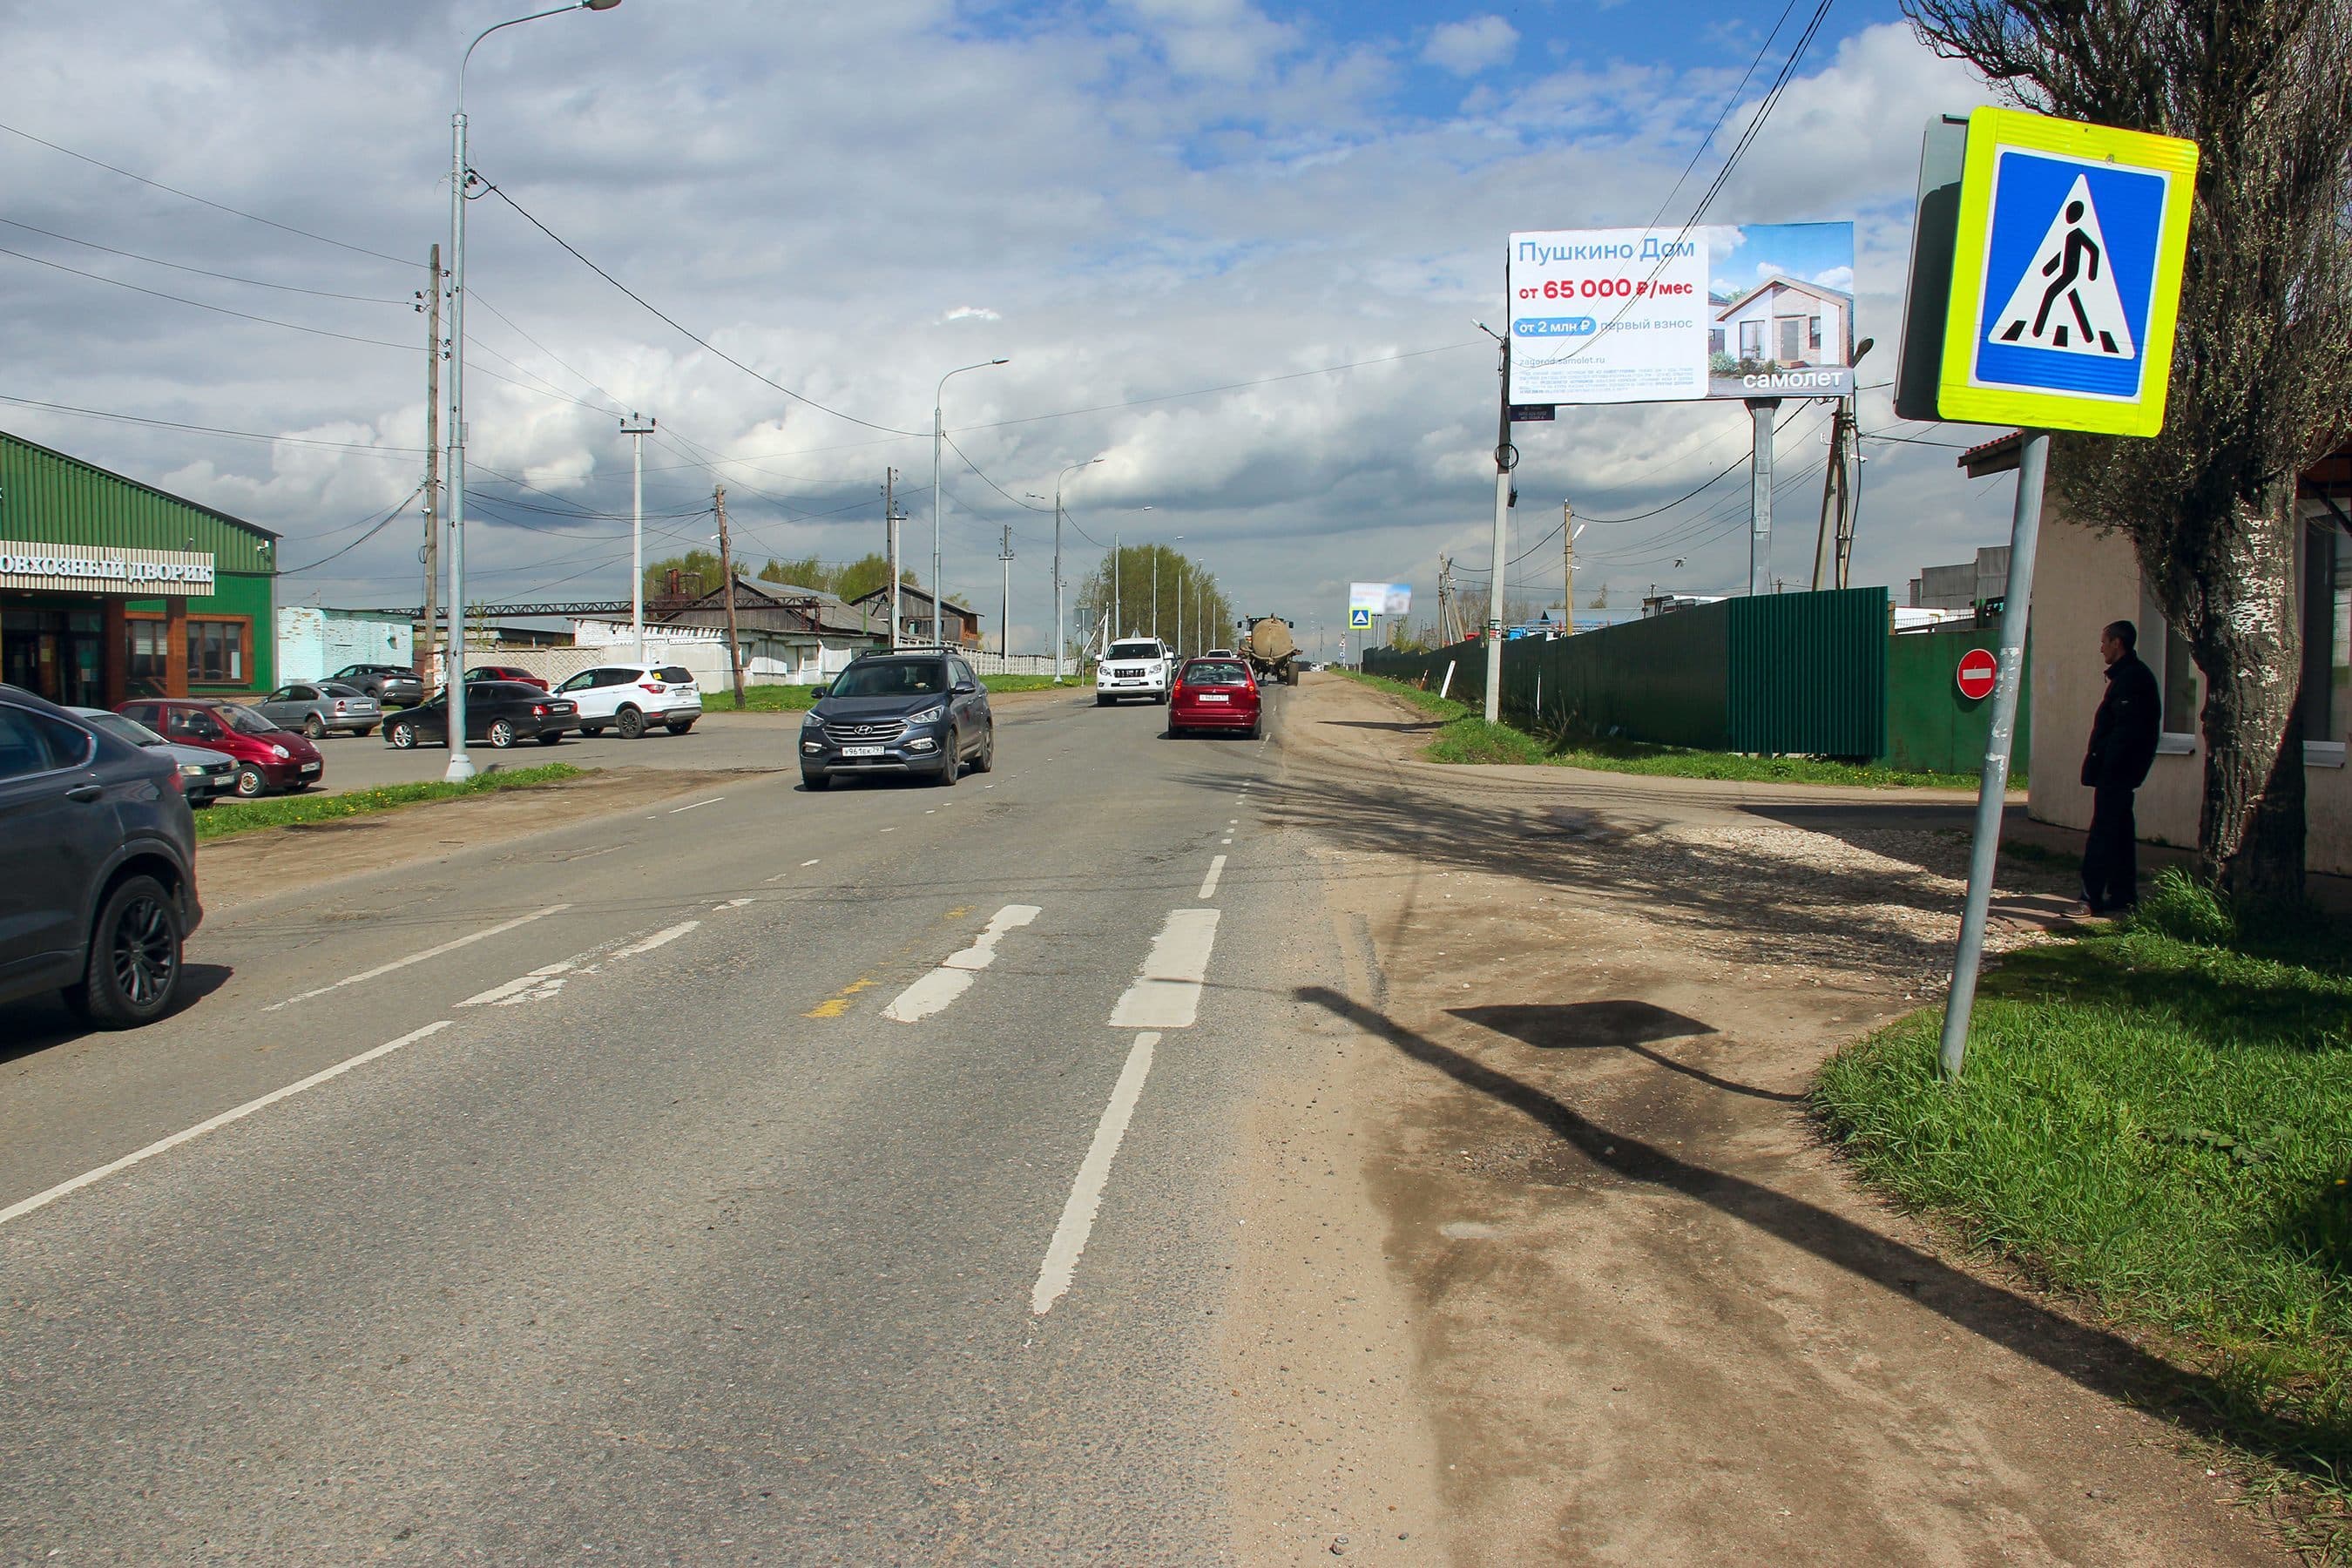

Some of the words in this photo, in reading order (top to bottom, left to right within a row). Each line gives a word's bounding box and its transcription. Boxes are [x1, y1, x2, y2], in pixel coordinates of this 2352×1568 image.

[1518, 242, 1634, 266] Пушкино
[1639, 237, 1695, 262] Дом
[1518, 288, 1539, 300] от
[1543, 280, 1575, 300] 65
[1580, 278, 1632, 299] 000
[1538, 321, 1548, 334] 2
[1550, 322, 1578, 334] млн
[1600, 319, 1651, 336] первый
[1653, 319, 1694, 329] взнос
[1742, 371, 1844, 389] самолет
[129, 562, 213, 586] ДВОРИК
